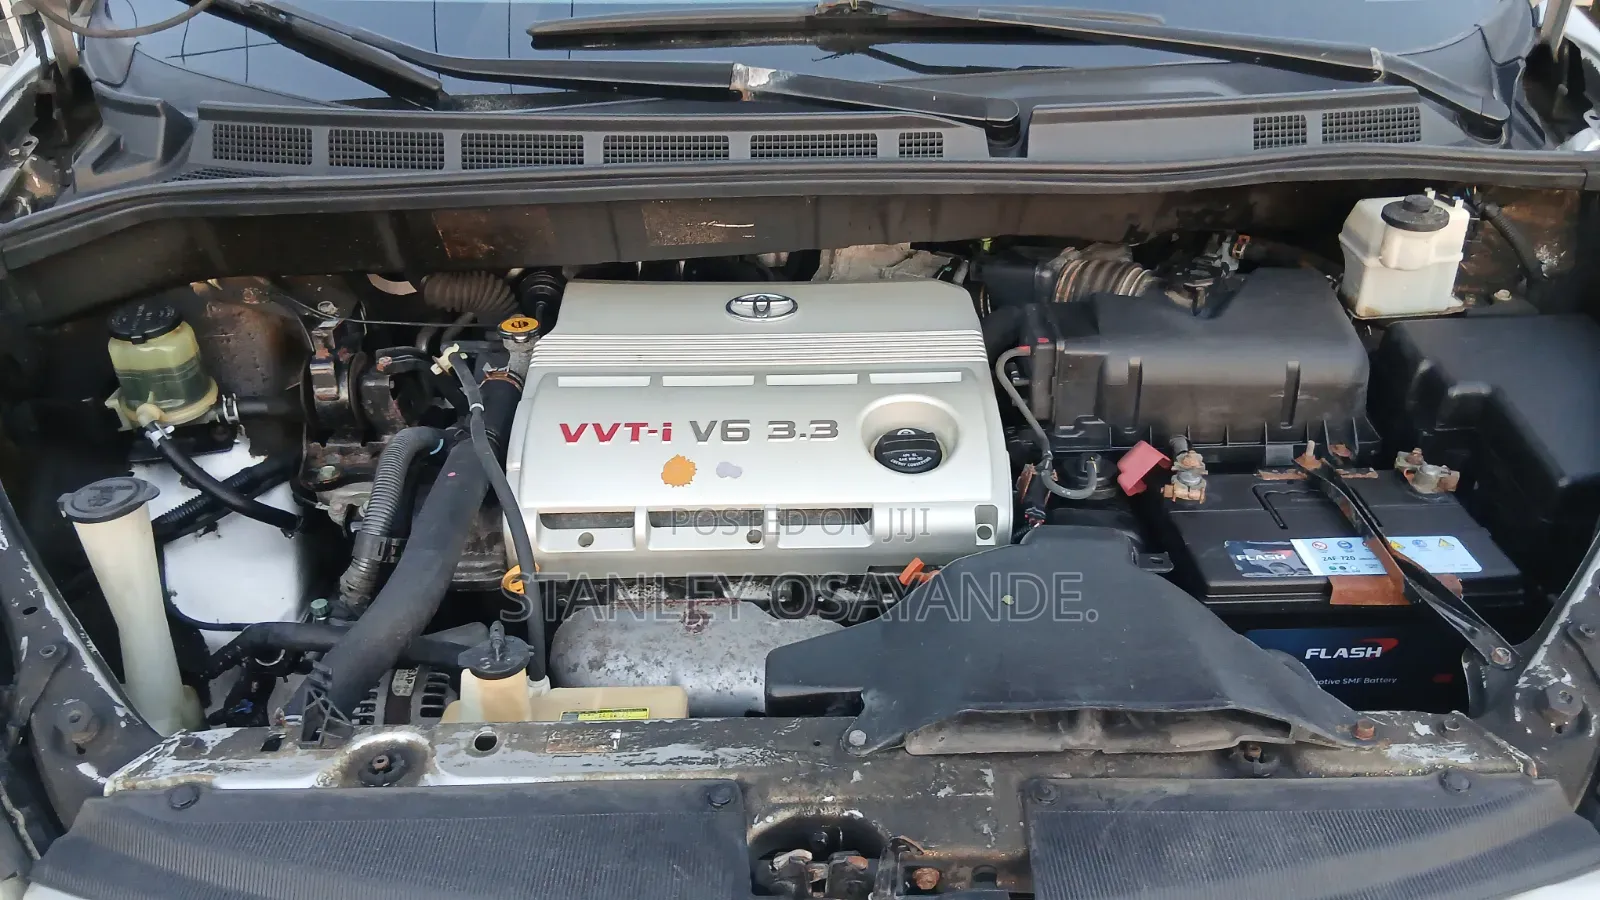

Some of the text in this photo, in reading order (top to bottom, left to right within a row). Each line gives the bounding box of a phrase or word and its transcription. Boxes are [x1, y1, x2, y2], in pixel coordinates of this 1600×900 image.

[559, 419, 839, 445] VVT-i V6 3.3
[1304, 646, 1383, 659] FLASH
[1343, 677, 1361, 685] SMF
[1363, 676, 1397, 685] Battery
